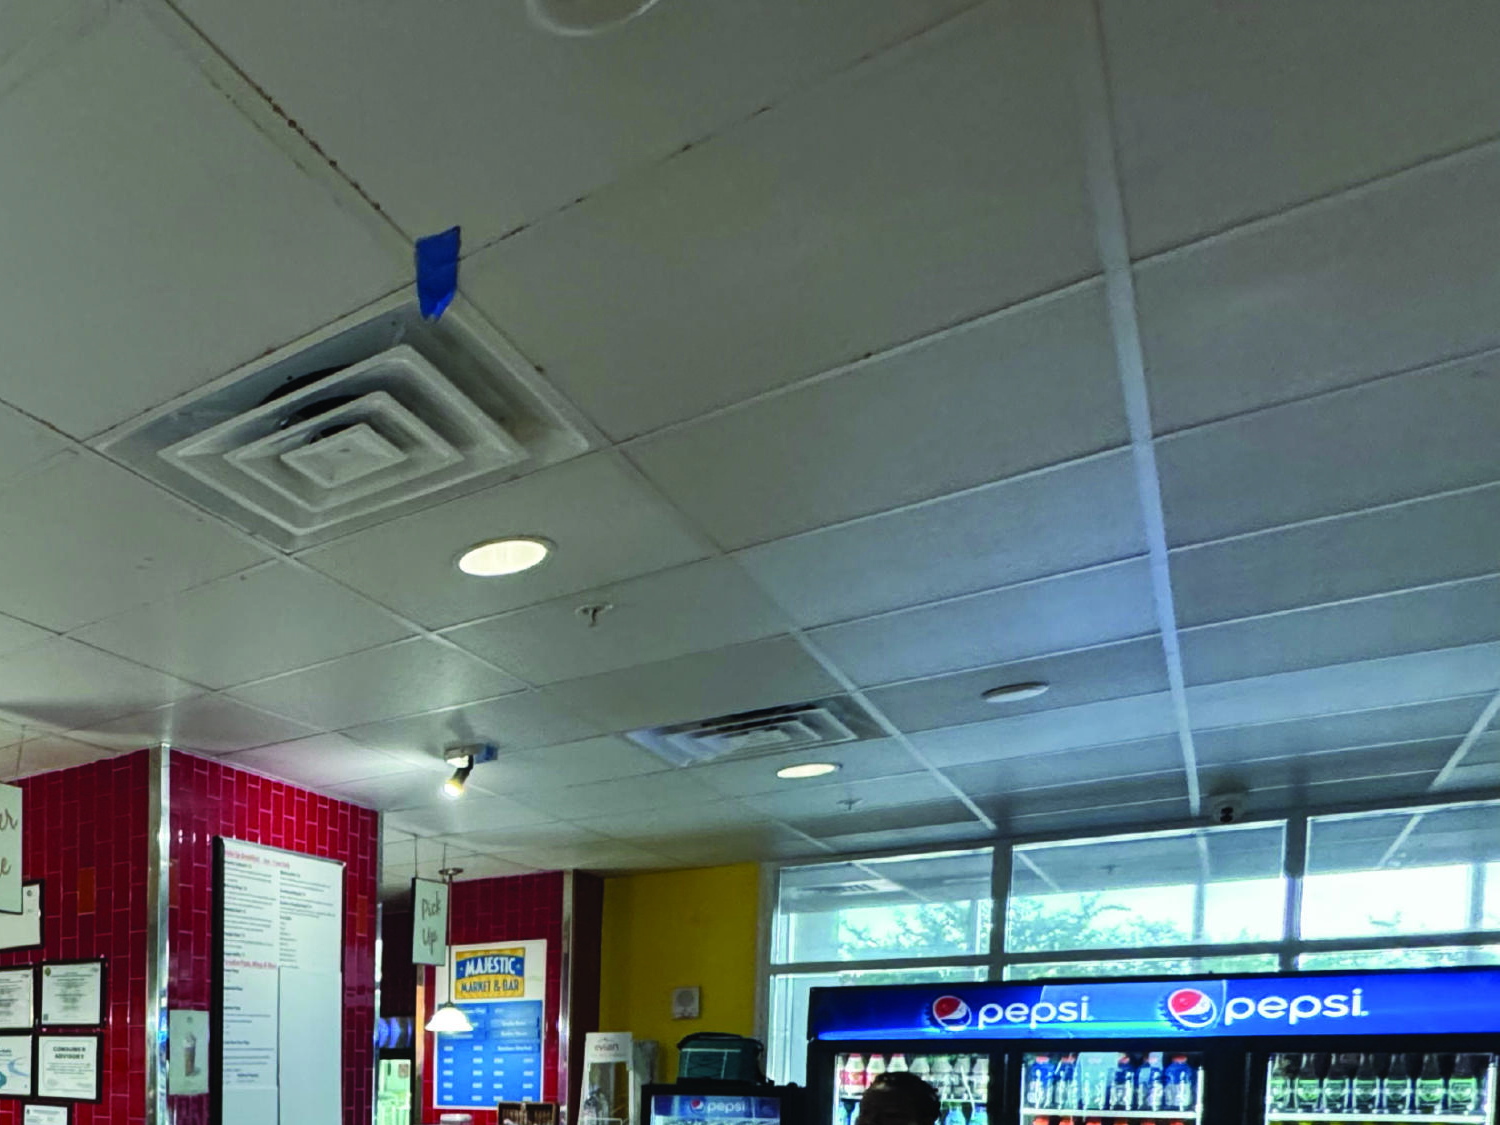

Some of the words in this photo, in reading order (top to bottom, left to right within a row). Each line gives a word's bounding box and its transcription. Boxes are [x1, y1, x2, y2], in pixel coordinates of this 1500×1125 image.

[420, 890, 442, 921] Pick
[421, 928, 439, 956] Up
[463, 956, 517, 977] MAJESTIC
[460, 979, 491, 994] MARKET
[502, 978, 520, 993] BAR
[977, 995, 1090, 1030] pepsi
[1224, 987, 1364, 1026] pepsi
[707, 1101, 746, 1113] pepsi
